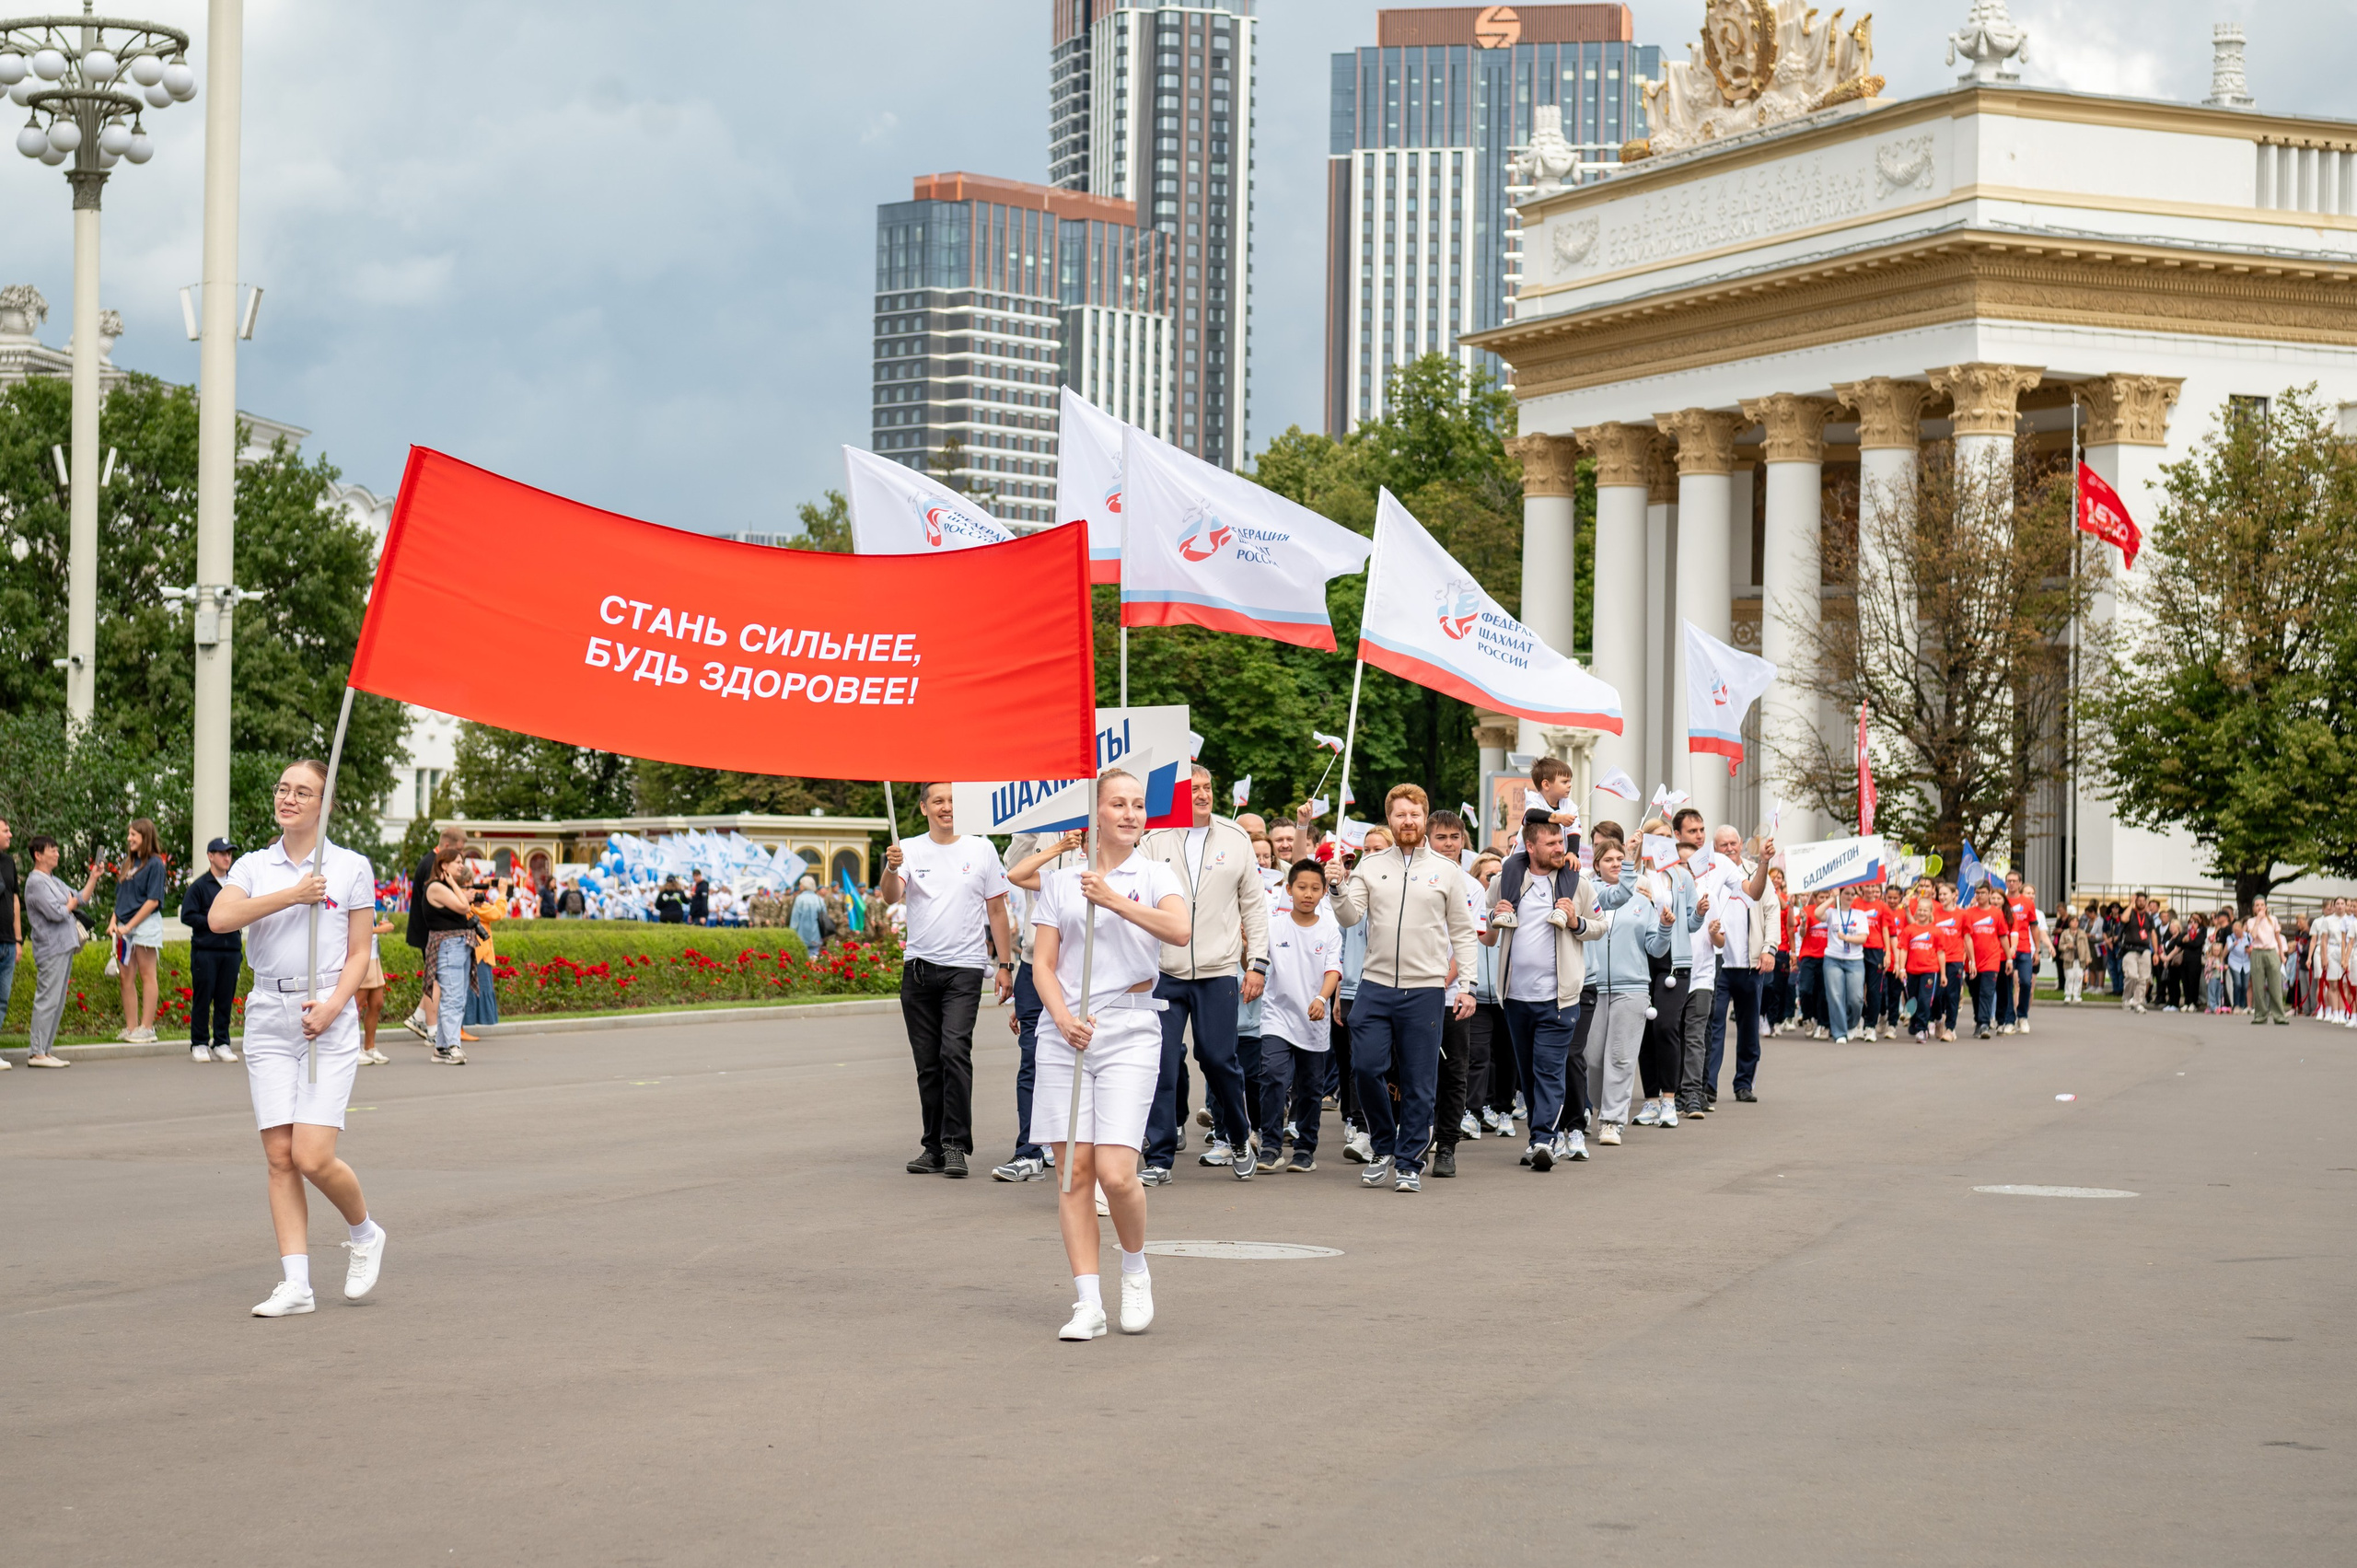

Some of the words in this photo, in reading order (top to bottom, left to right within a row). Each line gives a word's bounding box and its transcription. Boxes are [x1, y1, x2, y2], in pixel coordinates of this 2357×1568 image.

[1608, 205, 1708, 246] СОВЕТСКАЯ
[1716, 167, 1866, 221] ФЕДЕРАТИВНАЯ
[1643, 155, 1824, 217] РОССИЙСКАЯ
[1608, 216, 1758, 267] СОЦИАЛИСТИЧЕСКАЯ
[1765, 193, 1867, 232] РЕСПУБЛИКА
[599, 595, 727, 646] СТАНЬ
[739, 623, 921, 667] СИЛЬНЕЕ,
[1478, 642, 1528, 669] РОССИИ
[1479, 627, 1535, 653] ШАХМАТ
[584, 636, 690, 686] БУДЬ
[699, 661, 919, 704] ЗДОРОВЕЕ!
[1804, 844, 1859, 889] БАДМИНТОН
